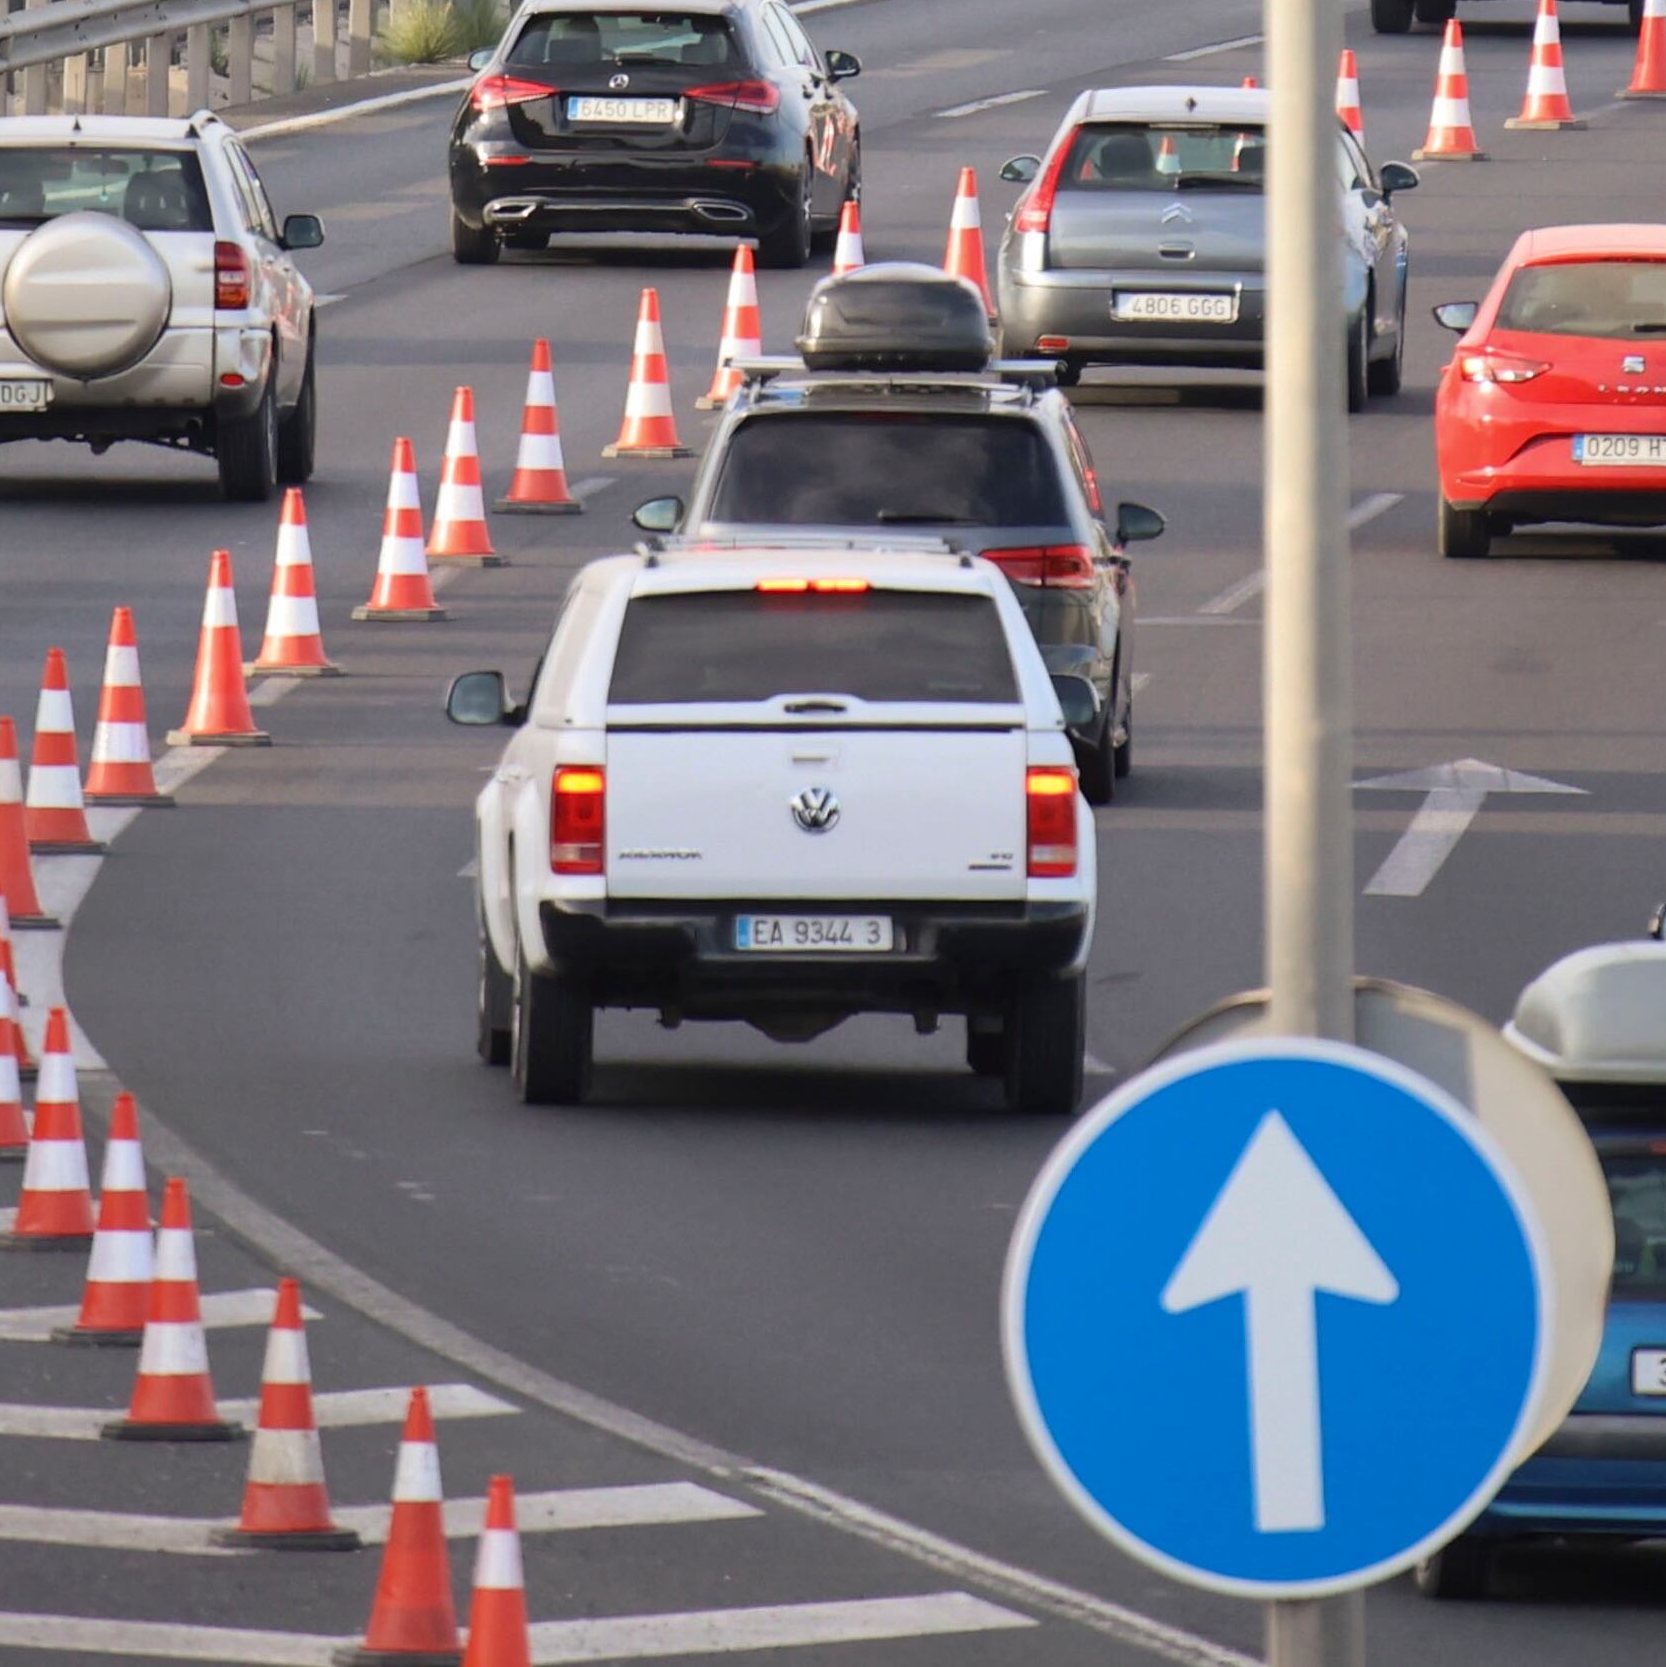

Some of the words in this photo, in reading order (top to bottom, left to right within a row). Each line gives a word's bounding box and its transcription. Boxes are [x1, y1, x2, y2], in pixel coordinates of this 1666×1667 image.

[581, 101, 627, 117] 6450
[633, 102, 668, 118] LPR
[1133, 297, 1181, 314] 4806
[1188, 298, 1225, 315] GGG
[1, 385, 41, 404] DGJ
[1587, 437, 1639, 457] 0209
[753, 920, 784, 945] EA
[794, 920, 851, 945] 9344
[867, 921, 881, 945] 3
